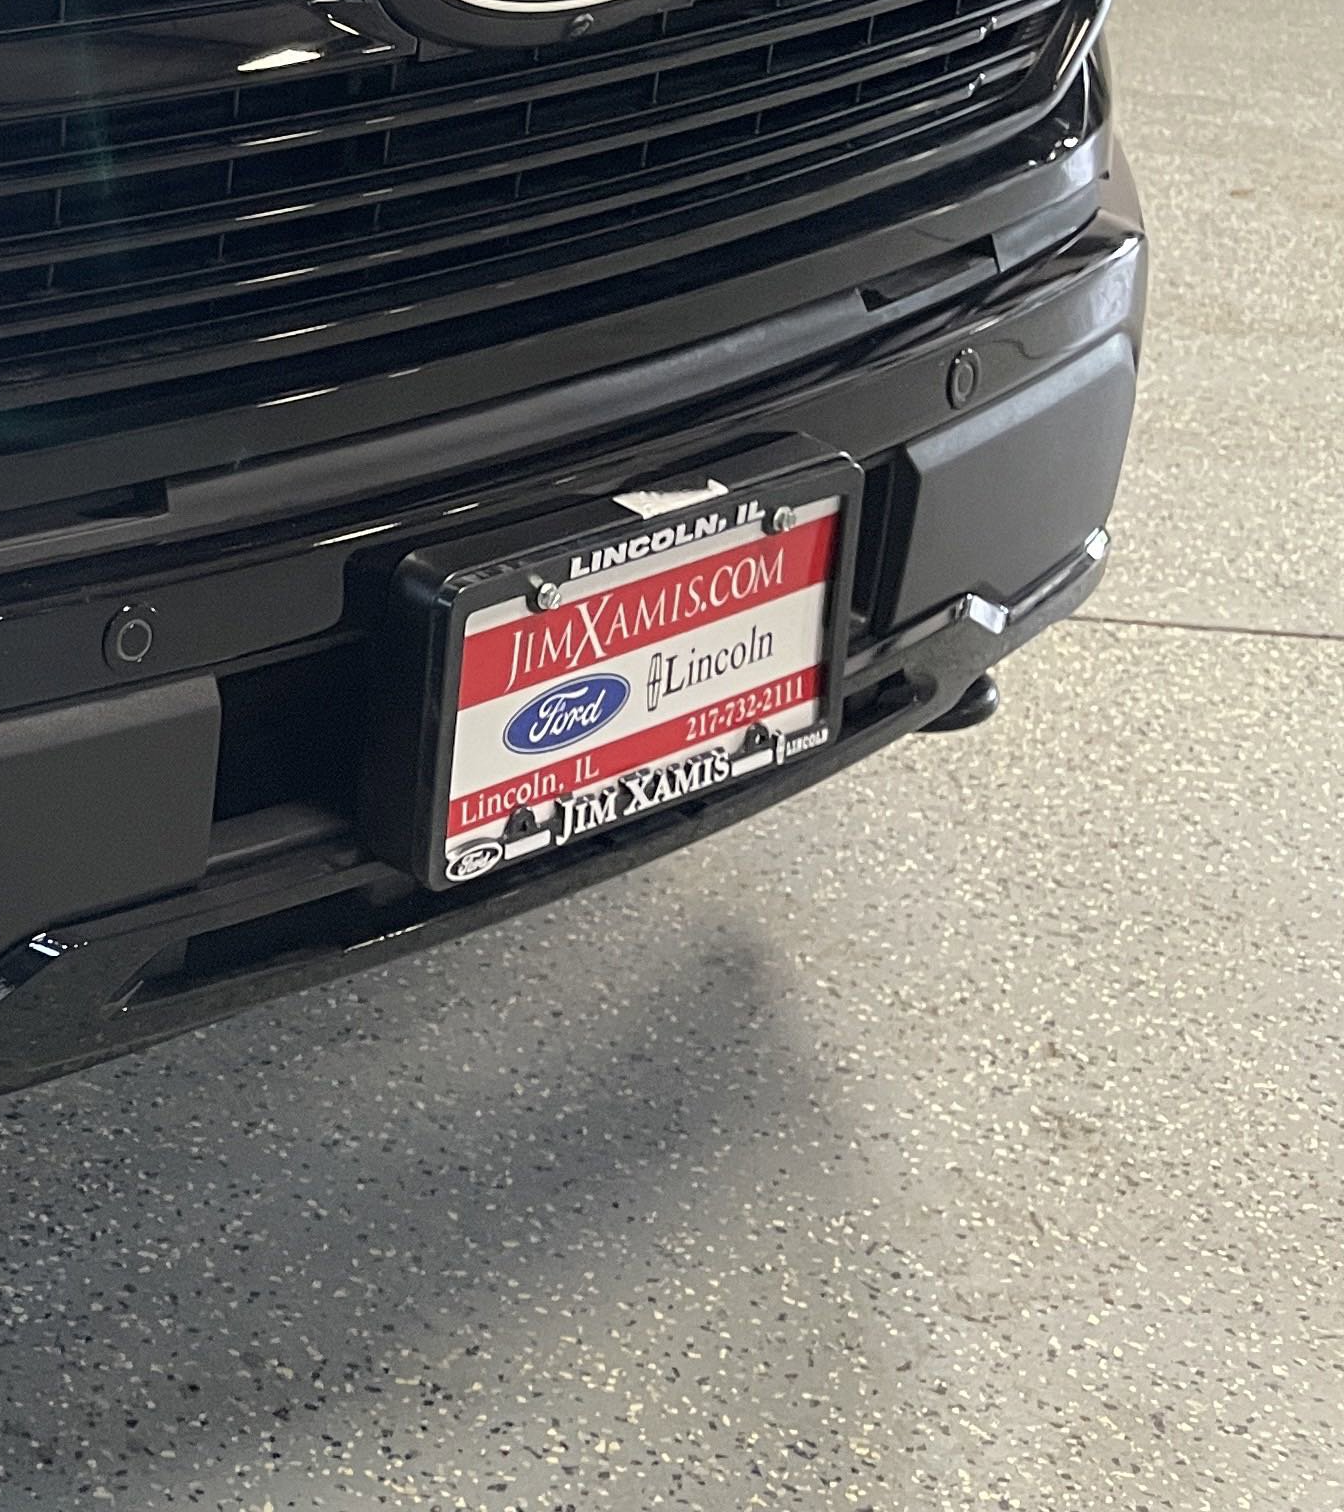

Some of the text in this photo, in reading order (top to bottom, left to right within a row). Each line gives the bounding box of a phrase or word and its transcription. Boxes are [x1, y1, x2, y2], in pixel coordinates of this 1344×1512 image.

[569, 499, 766, 580] LINCOLN, IL
[504, 546, 785, 694] JIMXAMIS.COM
[662, 625, 774, 697] Lincoln
[529, 686, 607, 744] Ford
[685, 675, 805, 741] 217-732-2111
[460, 754, 600, 827] Lincoln, IL
[555, 751, 730, 846] JIM XAMIS
[457, 850, 491, 876] Ford
